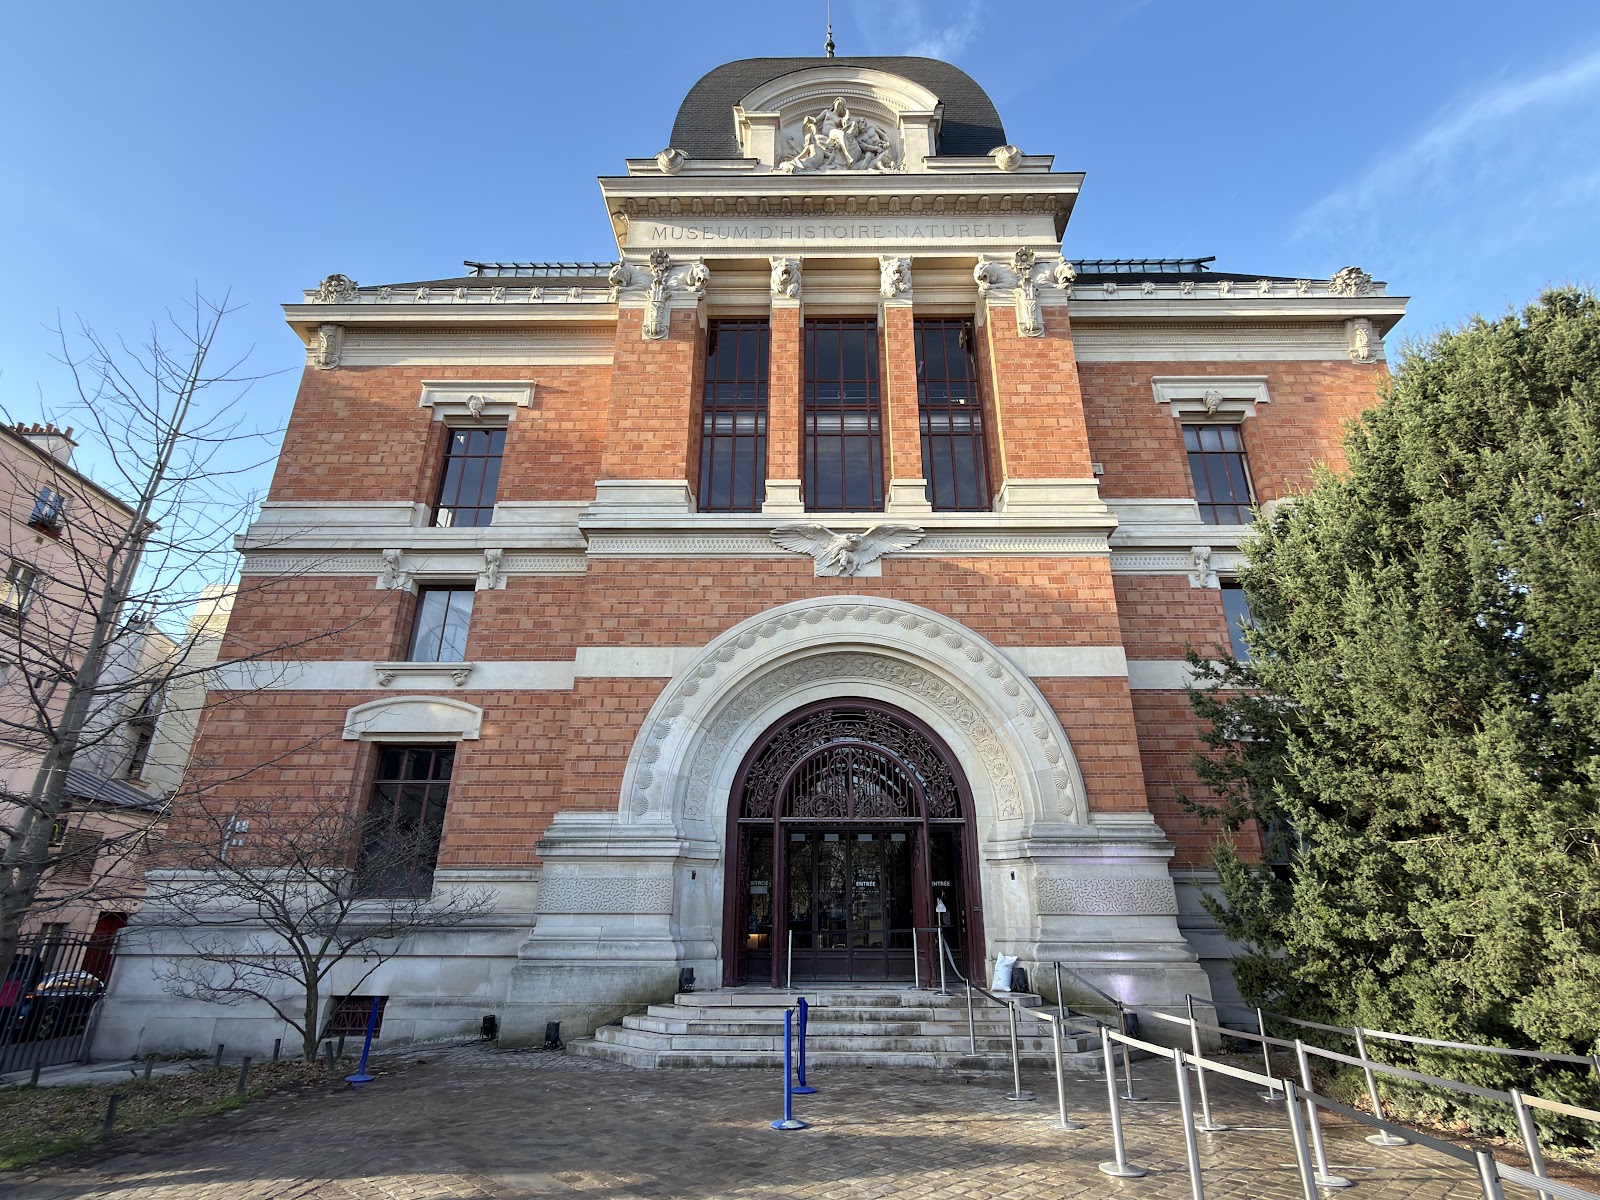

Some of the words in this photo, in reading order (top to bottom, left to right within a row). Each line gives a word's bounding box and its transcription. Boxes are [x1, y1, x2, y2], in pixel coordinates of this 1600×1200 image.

[651, 226, 748, 240] MUSEUM
[759, 225, 885, 240] D'HISTOIRE
[895, 224, 1030, 238] NATURELLE
